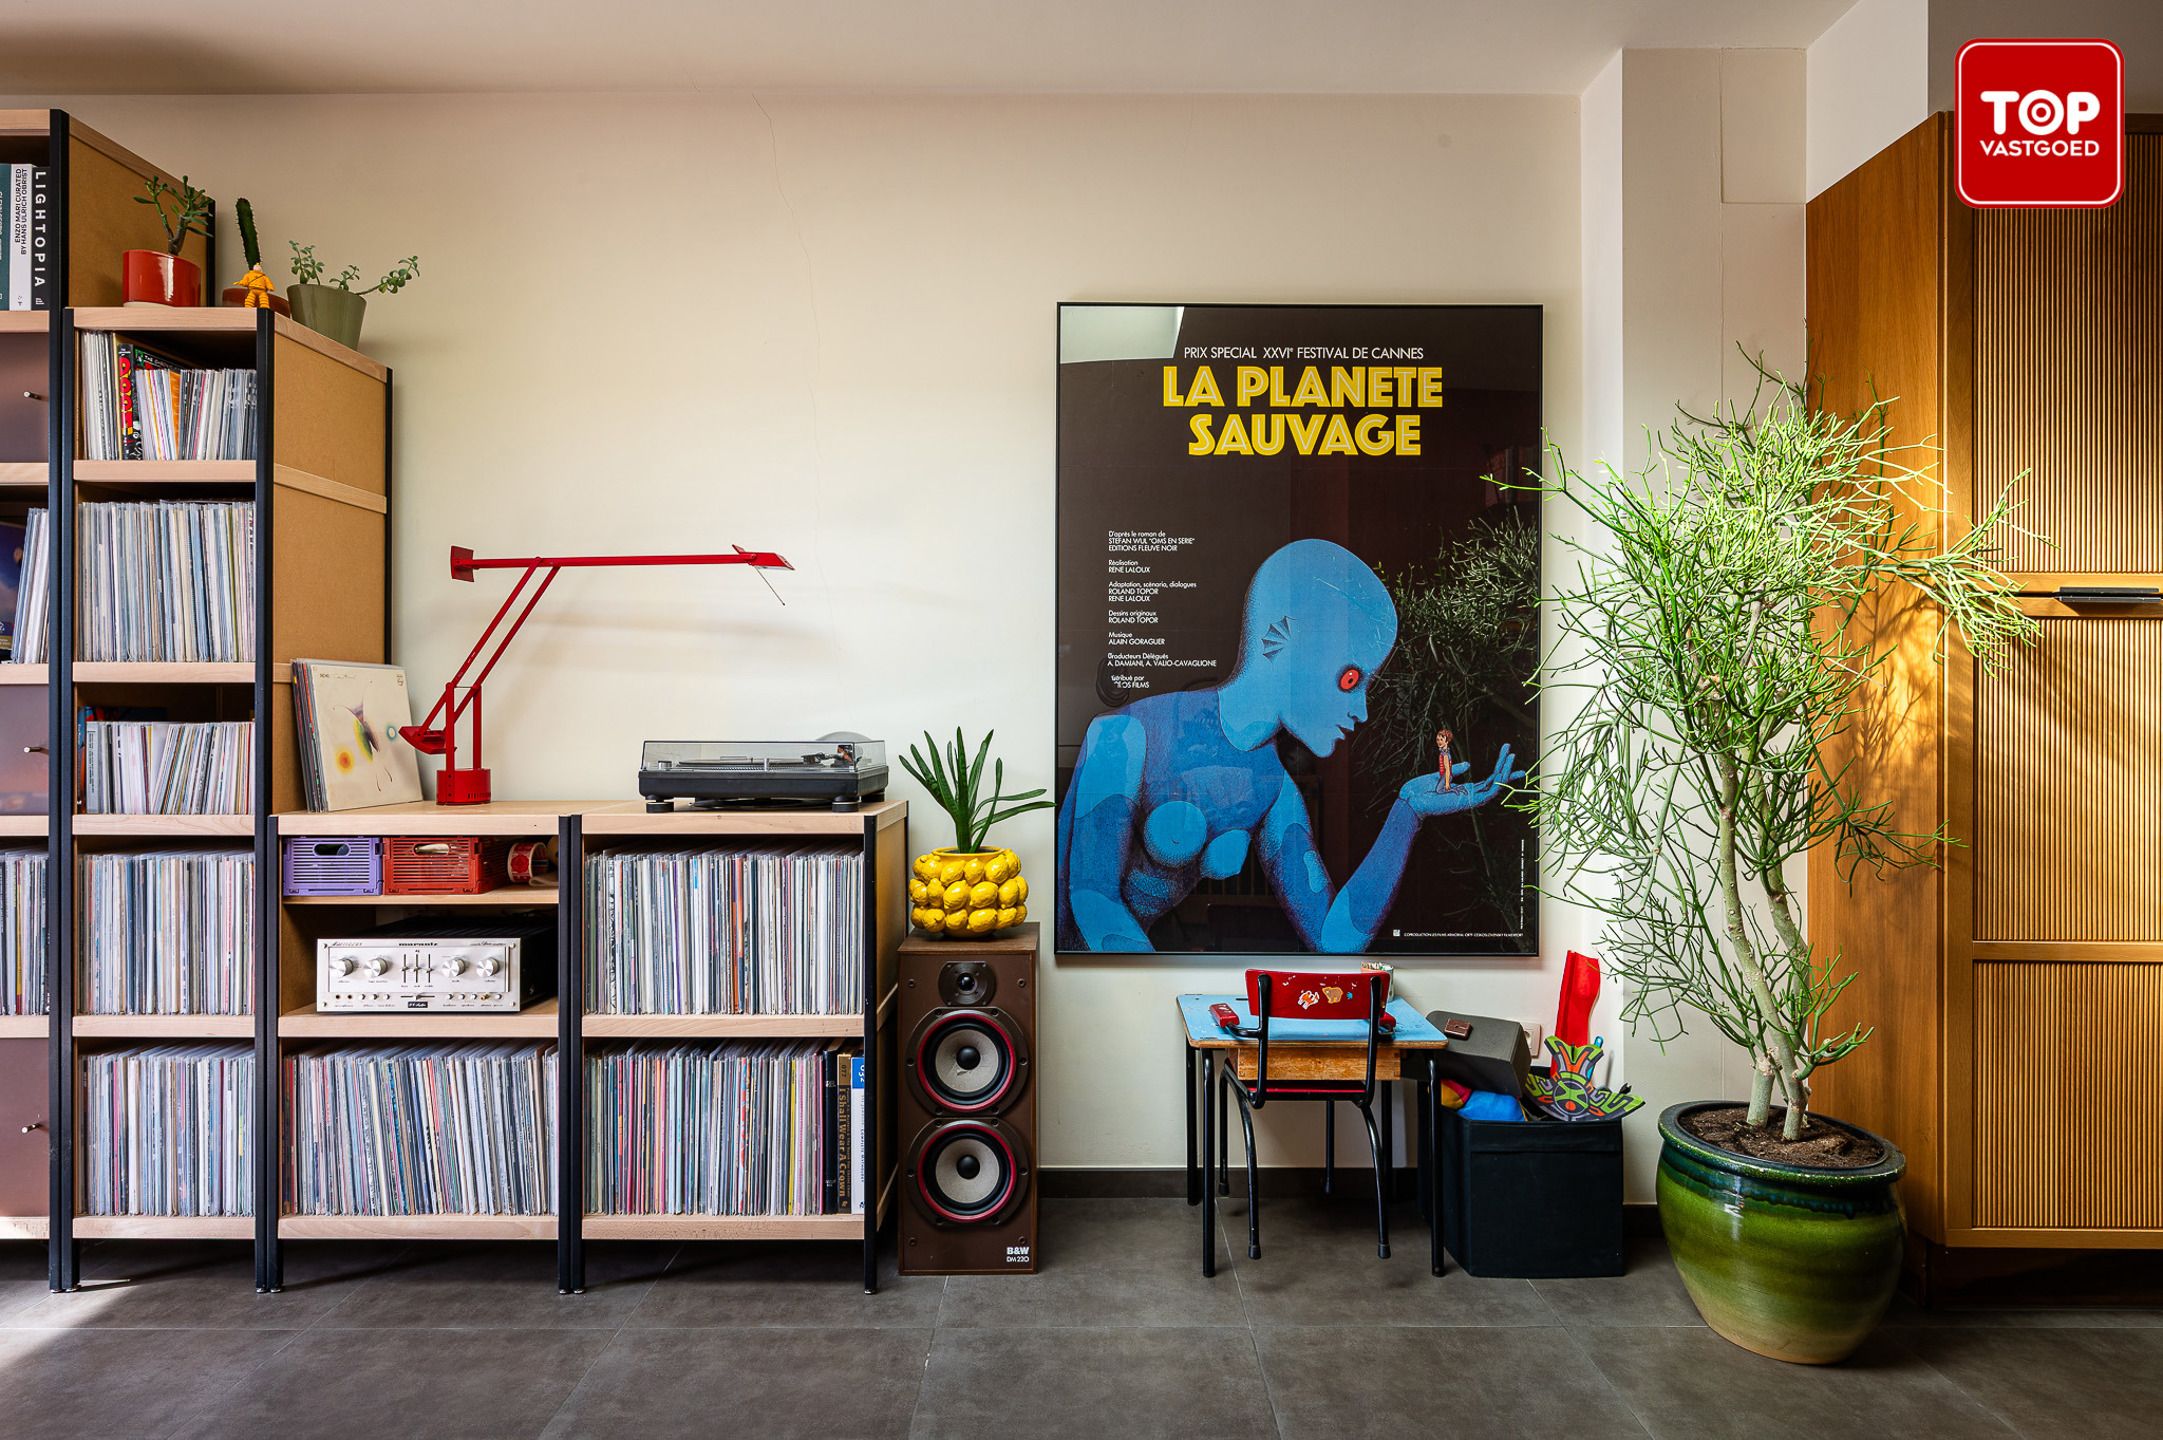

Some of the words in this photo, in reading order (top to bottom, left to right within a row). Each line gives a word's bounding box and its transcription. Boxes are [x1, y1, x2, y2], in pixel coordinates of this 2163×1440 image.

[34, 171, 46, 287] LIGHTOPIA
[21, 246, 27, 255] BY
[1184, 347, 1207, 358] PRIX
[1211, 347, 1257, 359] SPECIAL
[1297, 348, 1349, 359] FESTIVAL
[1352, 348, 1369, 359] DE
[1371, 348, 1424, 359] CANNES
[1162, 366, 1224, 407] LA
[1237, 366, 1443, 408] PLANETE
[1189, 413, 1421, 456] SAUVAGE
